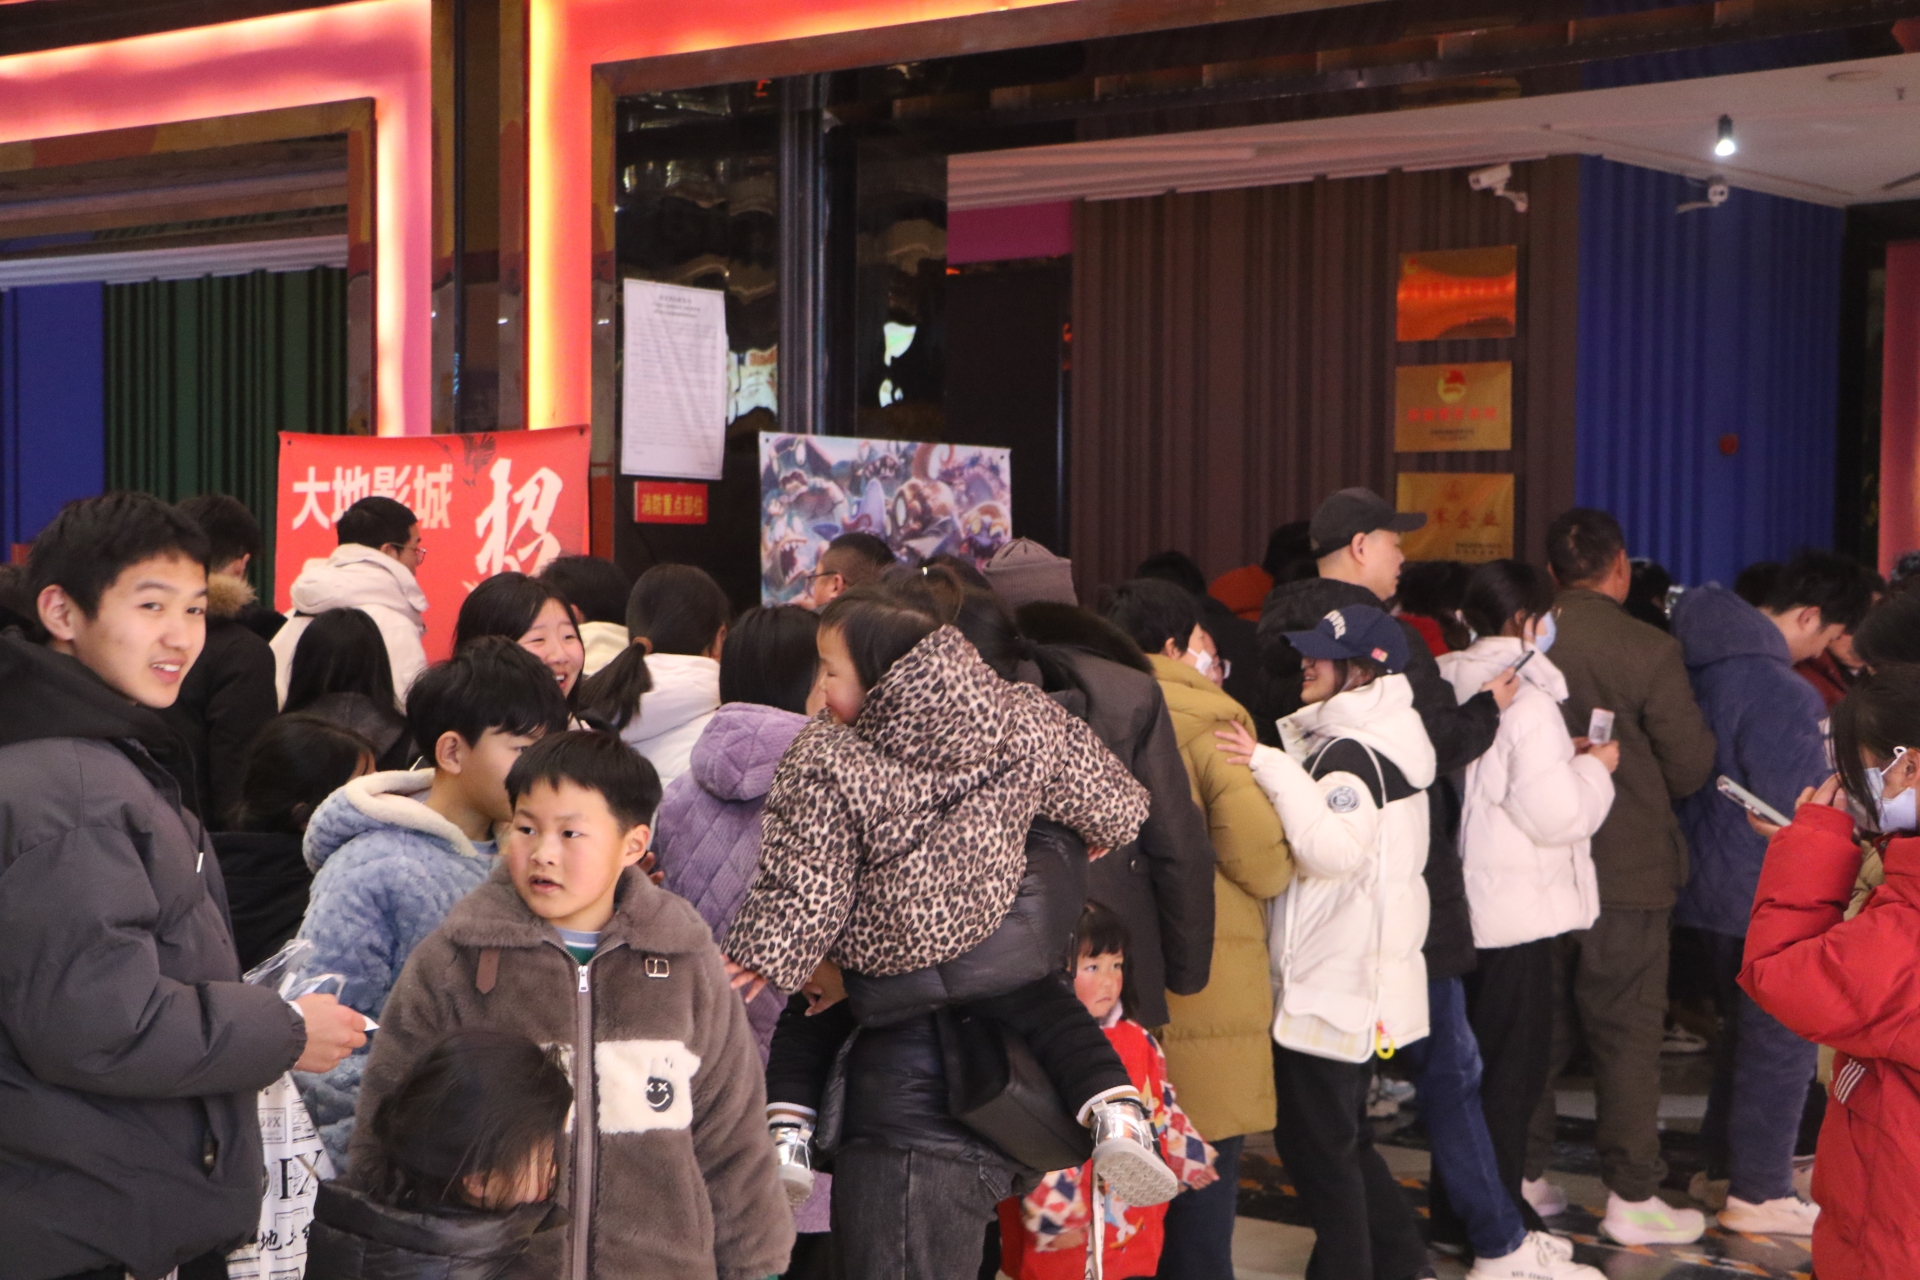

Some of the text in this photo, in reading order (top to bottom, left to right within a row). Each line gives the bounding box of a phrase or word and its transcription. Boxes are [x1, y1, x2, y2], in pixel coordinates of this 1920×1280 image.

[292, 463, 453, 531] 大地影城
[475, 457, 564, 578] 招
[641, 493, 704, 516] 消防重点部位
